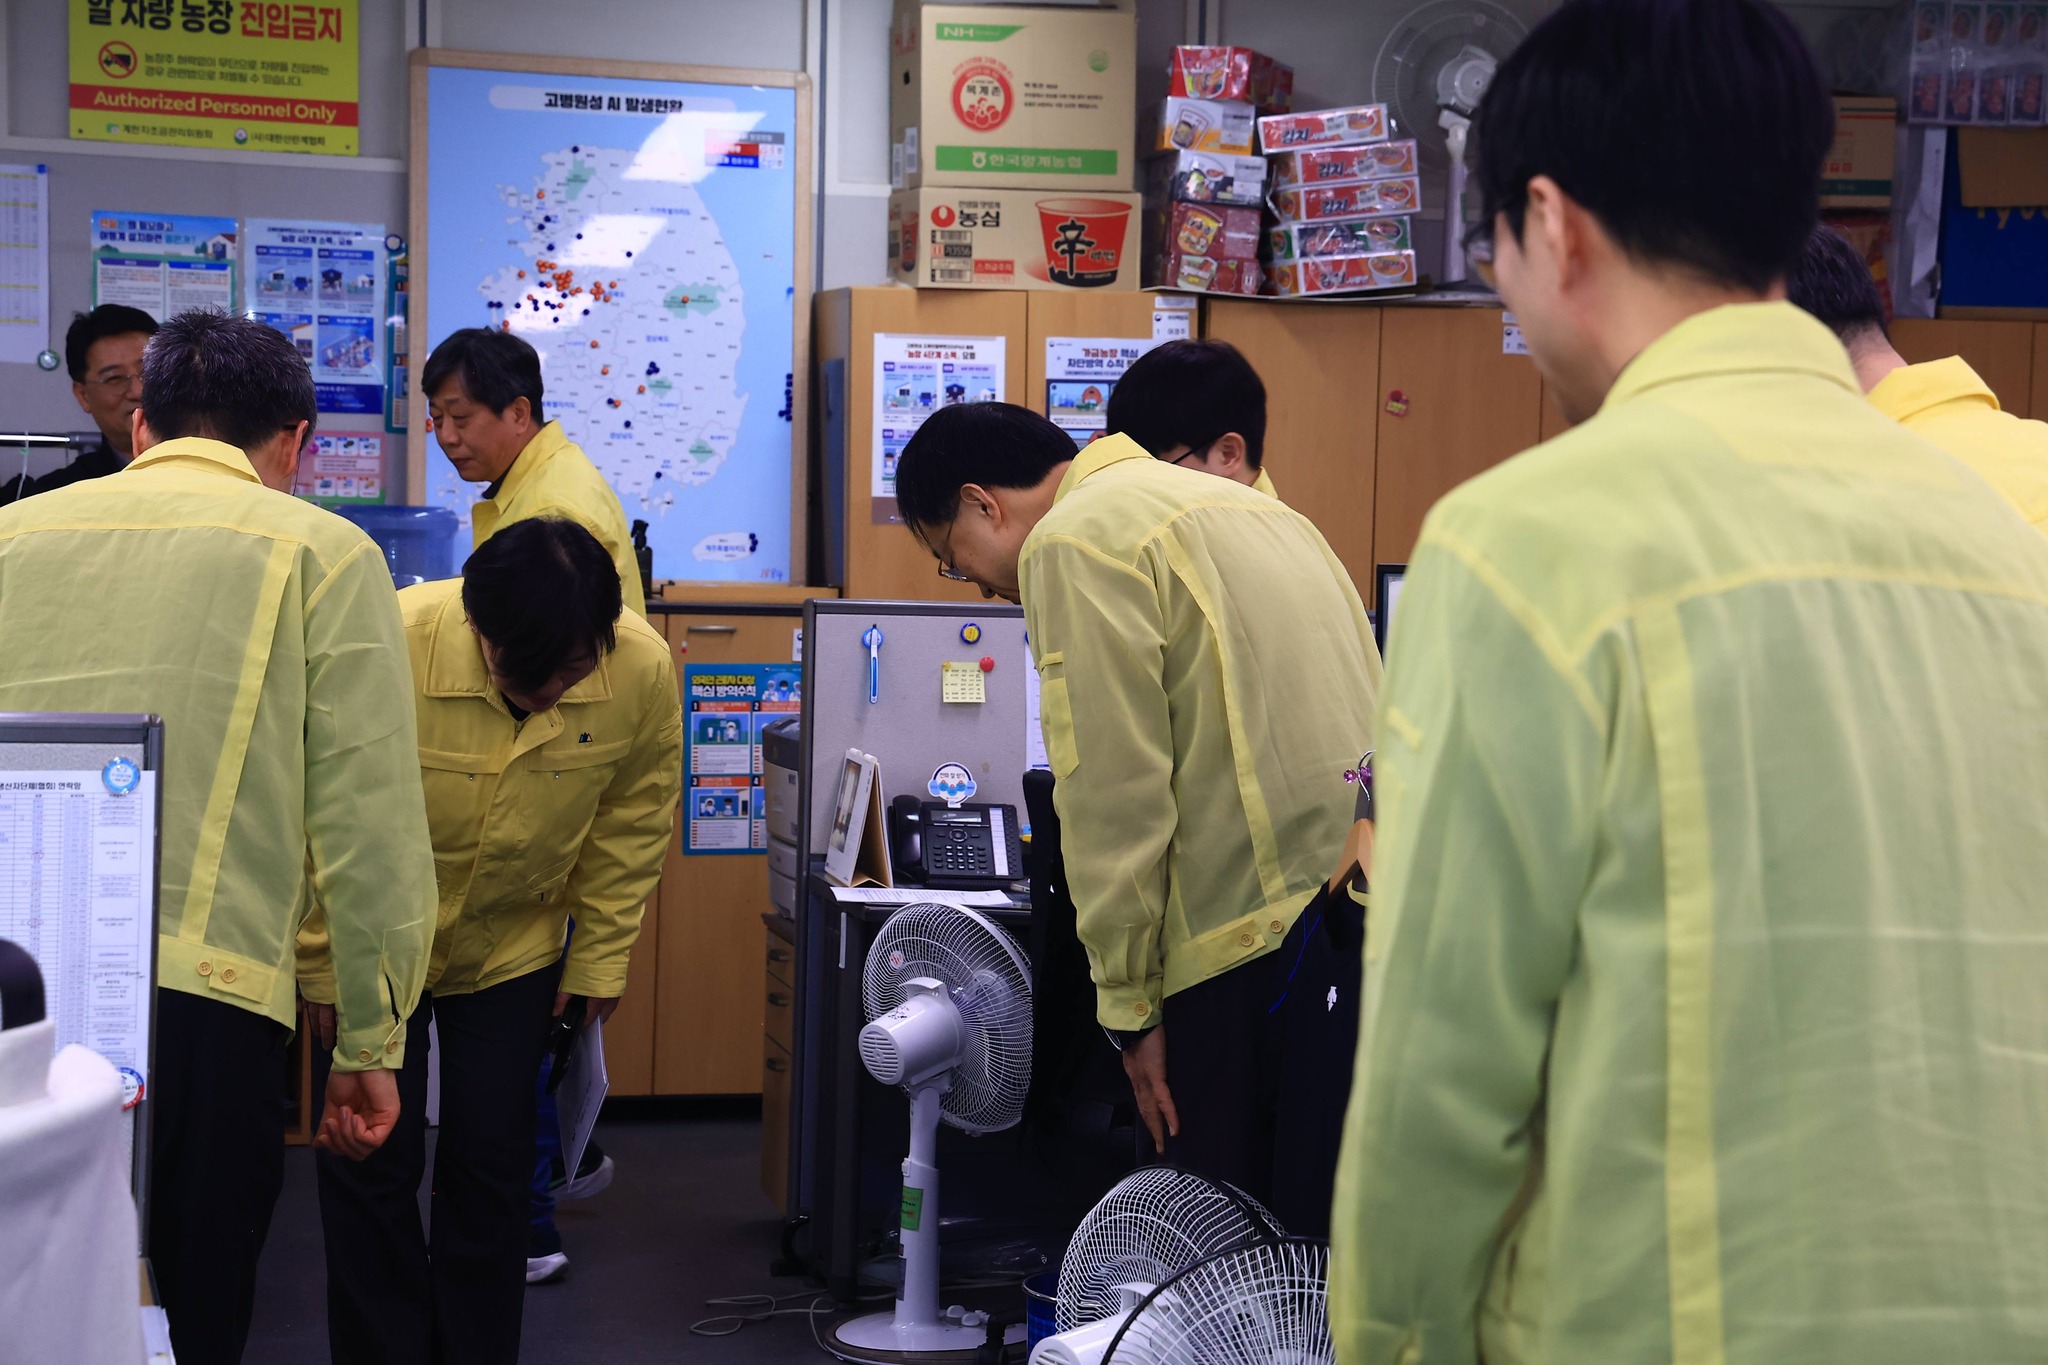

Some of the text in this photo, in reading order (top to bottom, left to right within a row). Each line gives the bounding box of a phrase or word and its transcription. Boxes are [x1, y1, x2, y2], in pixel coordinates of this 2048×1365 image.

[181, 0, 234, 35] 농장
[240, 2, 342, 43] 진입금지
[943, 27, 974, 37] NH
[218, 57, 257, 71] 무단으로
[260, 60, 289, 73] 차량을
[145, 66, 165, 78] 경우
[250, 73, 260, 84] 수
[262, 74, 303, 87] 있습니다.
[94, 90, 337, 124] Authorized Personnel Only
[545, 92, 683, 113] 고병원성 AI 발생현황
[959, 210, 1001, 228] 농심
[1053, 218, 1096, 279] 辛
[1082, 347, 1139, 359] 가금농장 핵심
[1067, 358, 1104, 369] 차단방역
[1106, 358, 1125, 369] 수칙
[691, 685, 757, 697] 핵심 방역수칙
